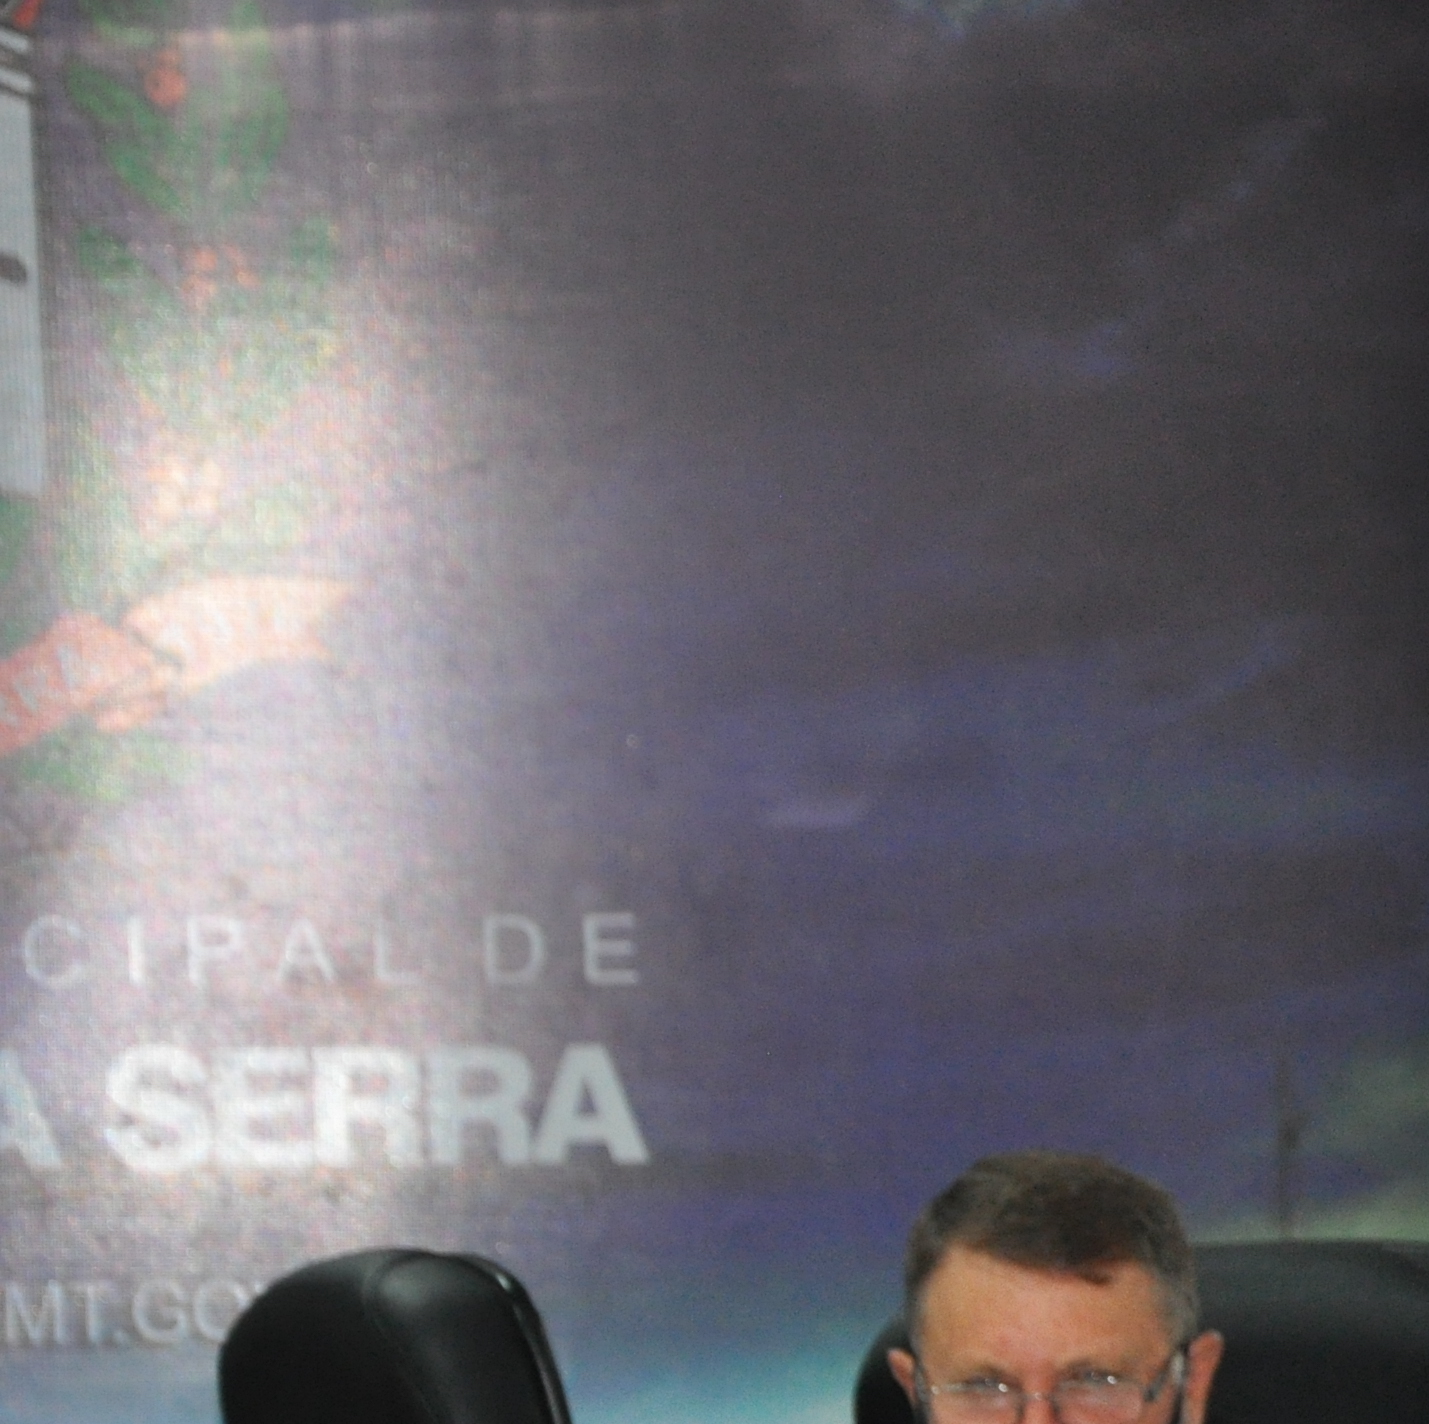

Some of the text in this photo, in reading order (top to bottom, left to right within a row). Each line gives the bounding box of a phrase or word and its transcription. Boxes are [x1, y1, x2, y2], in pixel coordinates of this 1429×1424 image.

[484, 910, 640, 986] DE
[104, 1042, 651, 1170] SERRA
[4, 1281, 265, 1345] MT.GO
